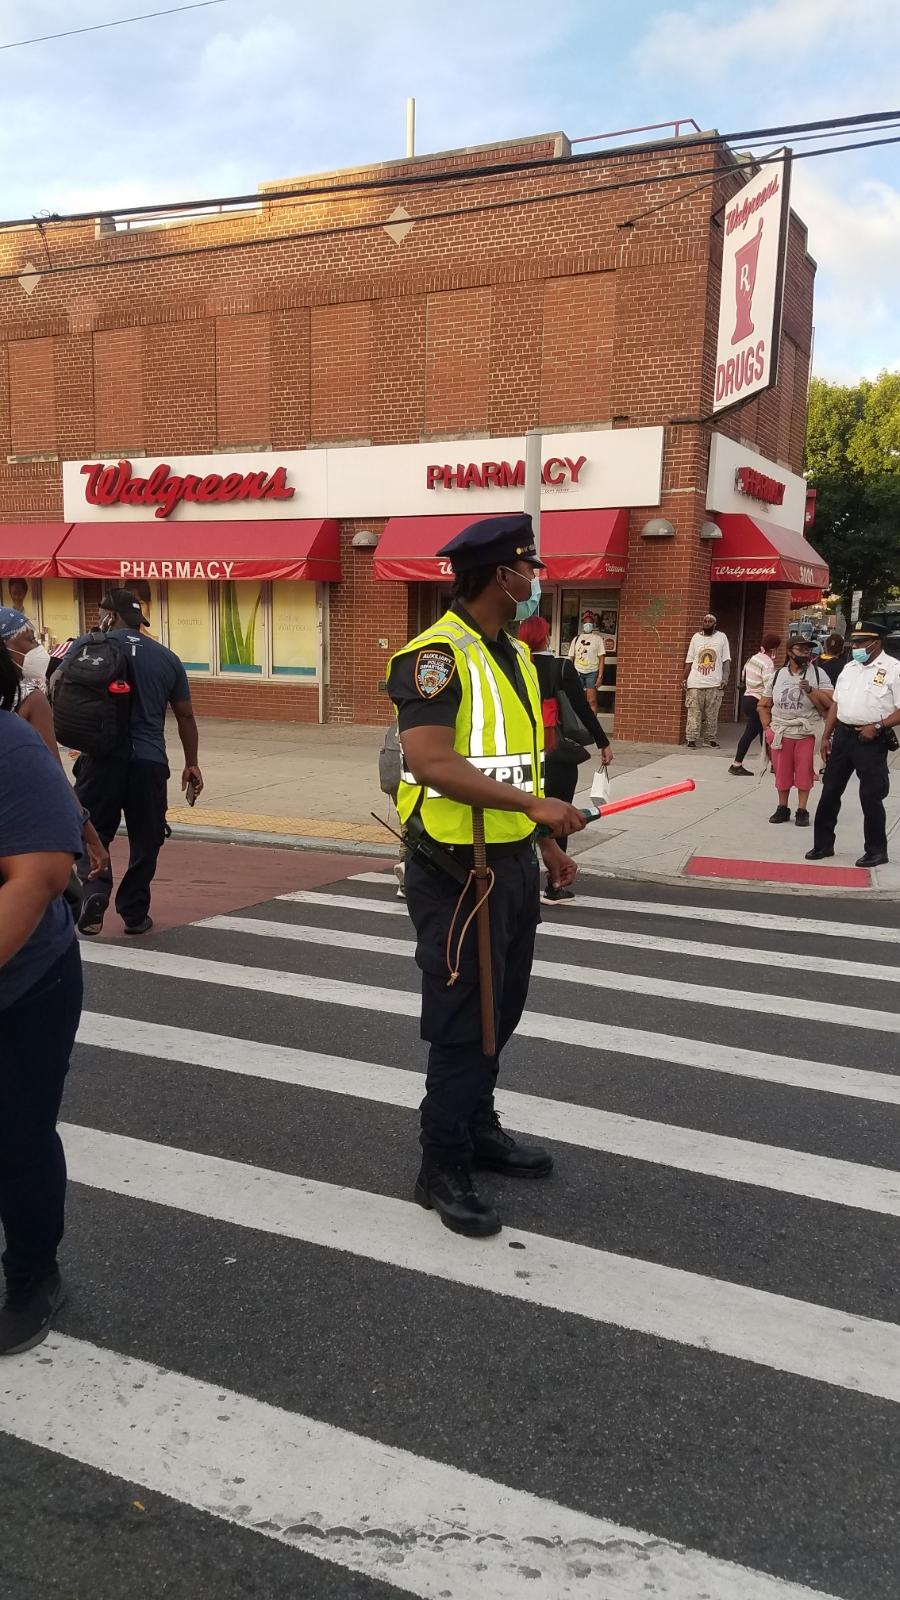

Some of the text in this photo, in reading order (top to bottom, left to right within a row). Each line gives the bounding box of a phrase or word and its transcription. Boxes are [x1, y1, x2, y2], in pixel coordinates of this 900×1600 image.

[726, 174, 779, 236] Walgreens
[715, 340, 765, 401] DRUGS
[80, 460, 295, 518] Walgreens
[426, 456, 587, 490] PHARMCY
[120, 561, 234, 579] PHARMACY
[714, 566, 776, 578] Walgreens
[423, 653, 452, 663] AUXILIARY
